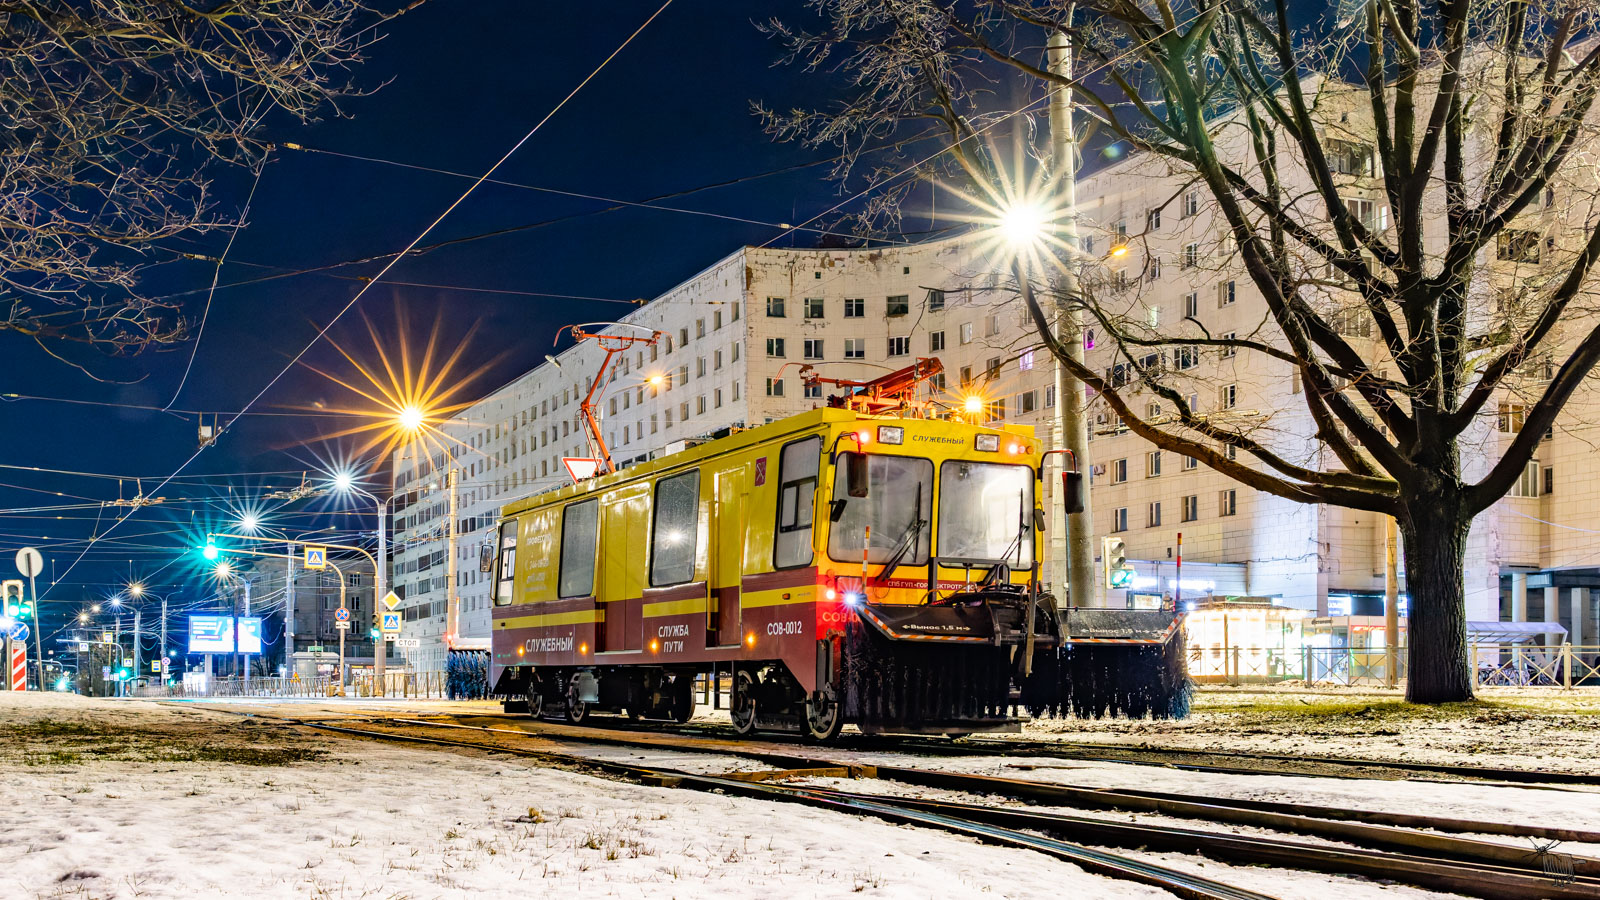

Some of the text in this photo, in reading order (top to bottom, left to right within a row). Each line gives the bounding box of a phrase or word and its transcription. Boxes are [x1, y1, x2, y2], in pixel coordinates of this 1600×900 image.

[912, 434, 964, 444] СЛУЖЕБНЫЙ
[658, 624, 689, 638] СЛУЖБА
[767, 620, 802, 635] СОВ-0012
[525, 631, 574, 653] СЛУЖЕБНЫЙ
[663, 641, 684, 653] ПУТИ
